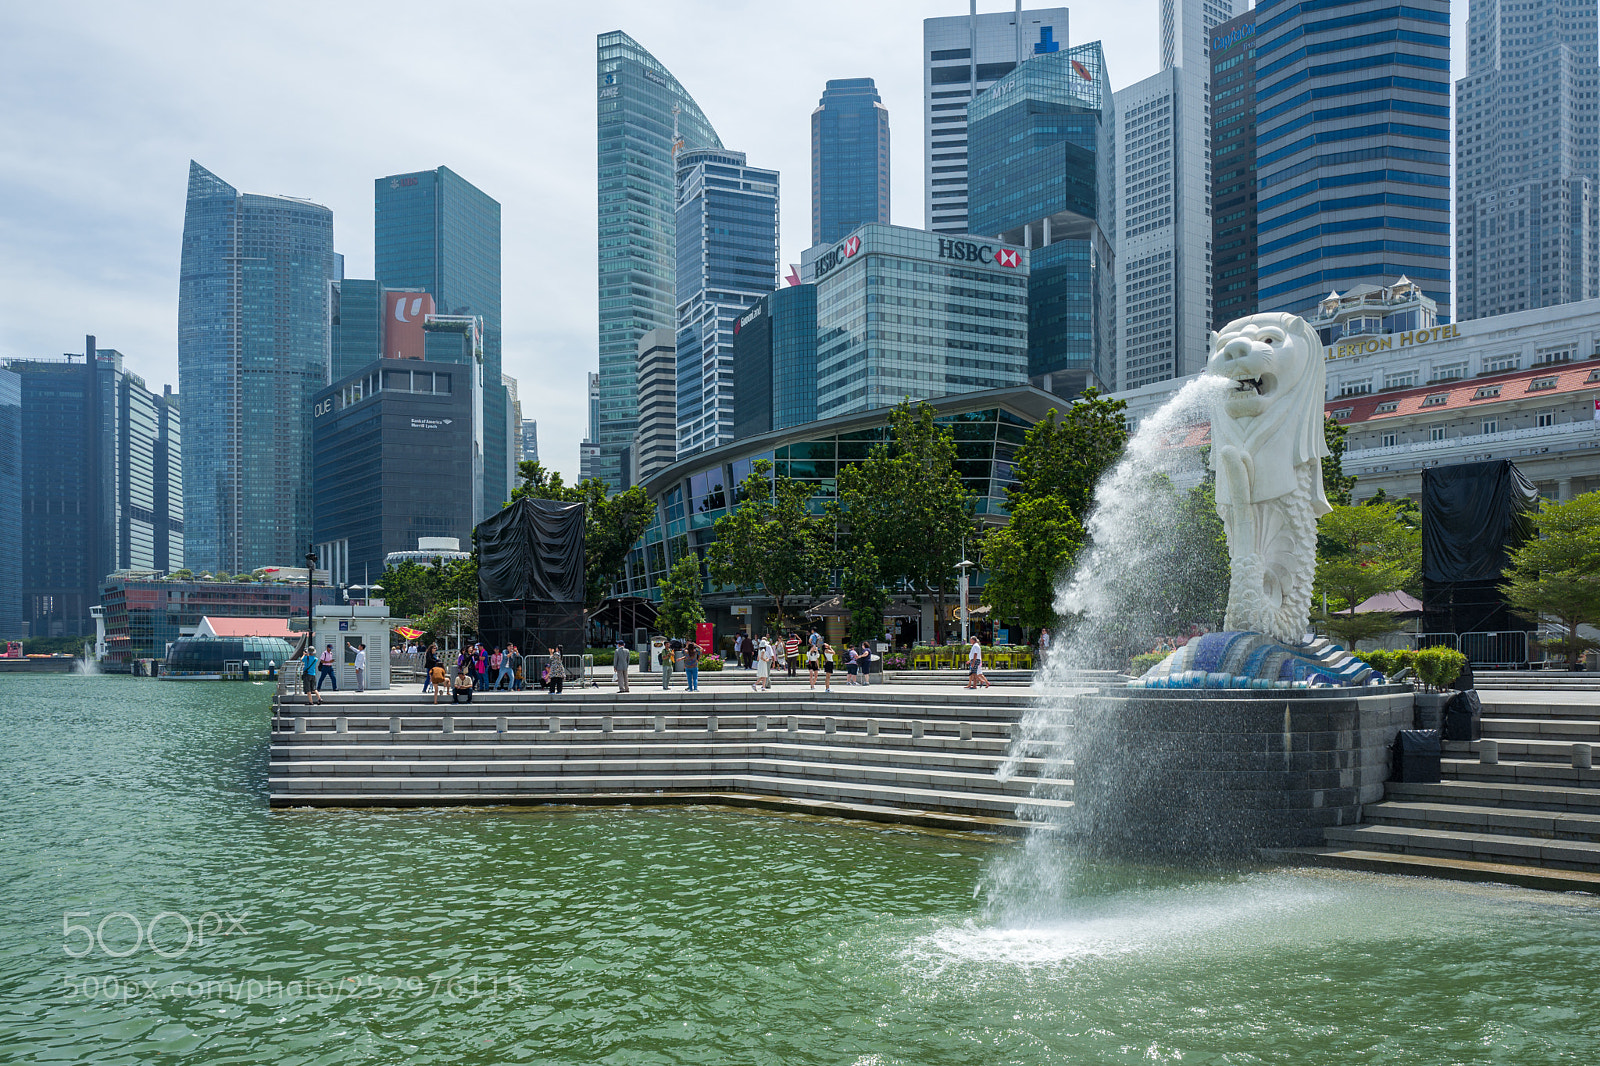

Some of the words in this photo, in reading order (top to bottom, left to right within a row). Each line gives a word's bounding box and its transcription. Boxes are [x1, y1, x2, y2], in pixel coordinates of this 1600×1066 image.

[645, 70, 667, 85] Keppel
[600, 87, 619, 98] ANZ
[992, 80, 1015, 99] MYP
[1069, 81, 1095, 94] MYP
[400, 177, 418, 187] UBS
[938, 238, 992, 264] HSBC
[813, 244, 845, 279] HSBC
[1324, 336, 1392, 360] LERTON
[1400, 324, 1461, 347] HOTEL
[314, 398, 332, 418] OUE
